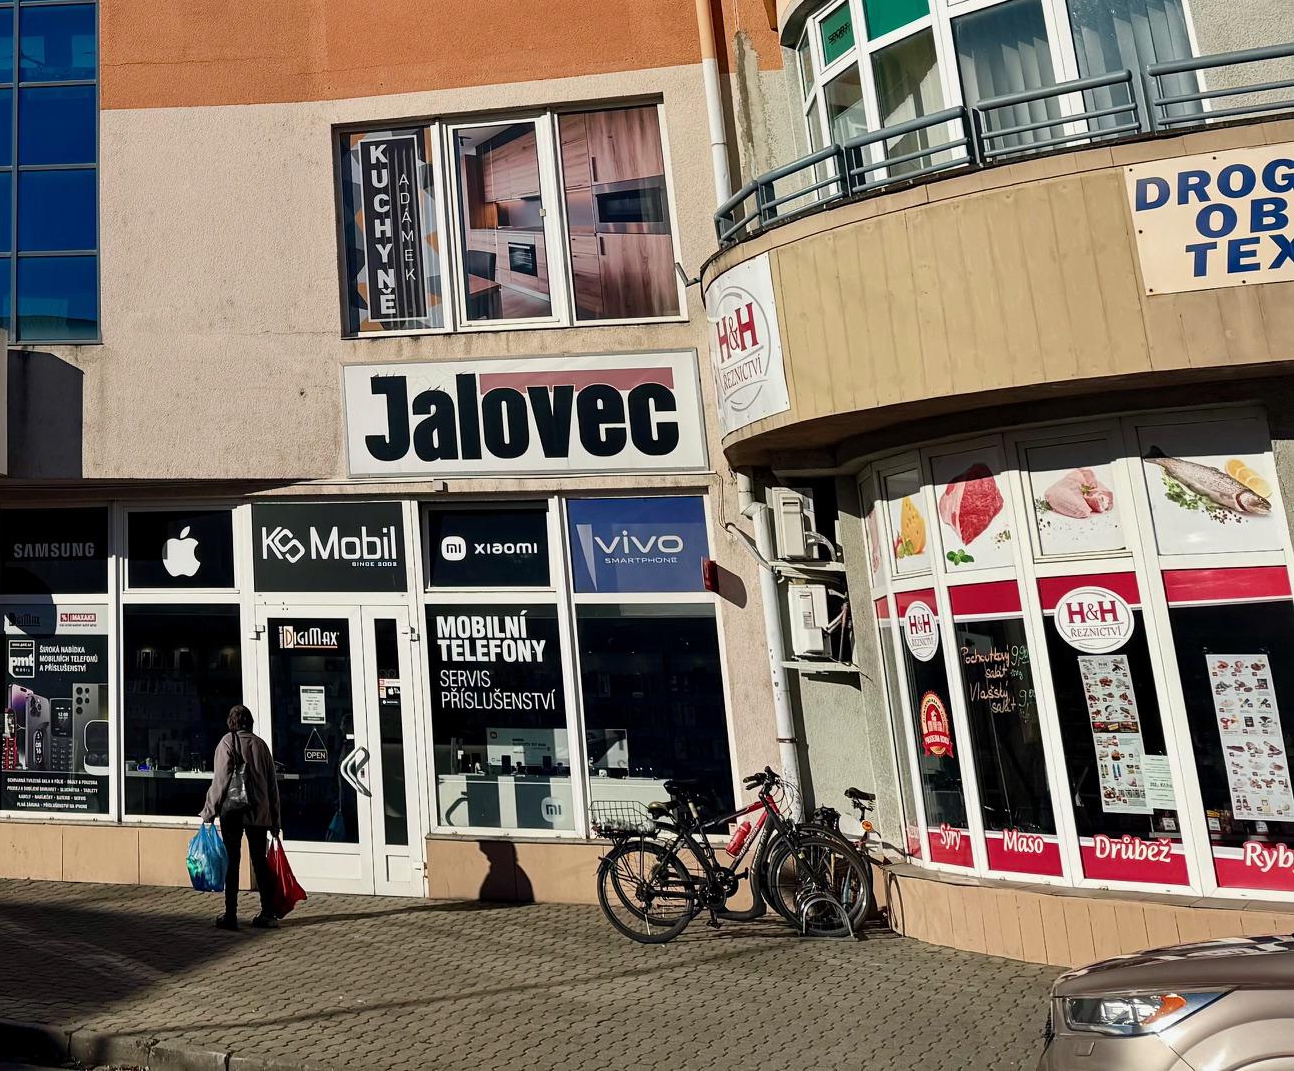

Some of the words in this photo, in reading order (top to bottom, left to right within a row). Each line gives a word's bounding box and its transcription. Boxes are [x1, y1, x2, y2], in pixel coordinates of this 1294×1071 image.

[1135, 158, 1294, 212] DROG
[369, 144, 396, 314] KUCHYNĚ
[398, 173, 416, 281] ADÁMEK
[1195, 197, 1289, 239] OB
[716, 302, 759, 364] H&H
[365, 372, 679, 463] Jalovec
[13, 542, 95, 558] SAMSUNG
[261, 526, 305, 564] KS
[309, 526, 397, 560] Mobil
[474, 542, 538, 555] xiaomi
[594, 530, 684, 554] vivo
[604, 556, 678, 564] SMARTPHONE
[908, 613, 932, 635] H&H
[1066, 600, 1120, 624] H&H
[436, 610, 528, 639] MOBILNÍ
[1070, 626, 1122, 638] ŘEZNICTVÍ
[39, 645, 60, 654] ŠIROKÁ
[60, 645, 85, 654] NABÍDKA
[39, 654, 70, 663] MOBILNÍCH
[437, 639, 546, 663] TELEFONY
[439, 670, 491, 688] SERVIS
[441, 687, 556, 710] PŘÍSLUŠENSTVÍ
[306, 751, 326, 759] OPEN
[940, 824, 961, 851] Sýry
[1003, 830, 1044, 854] Maso
[1094, 835, 1172, 864] Drůbež
[1245, 842, 1294, 873] Ryb
